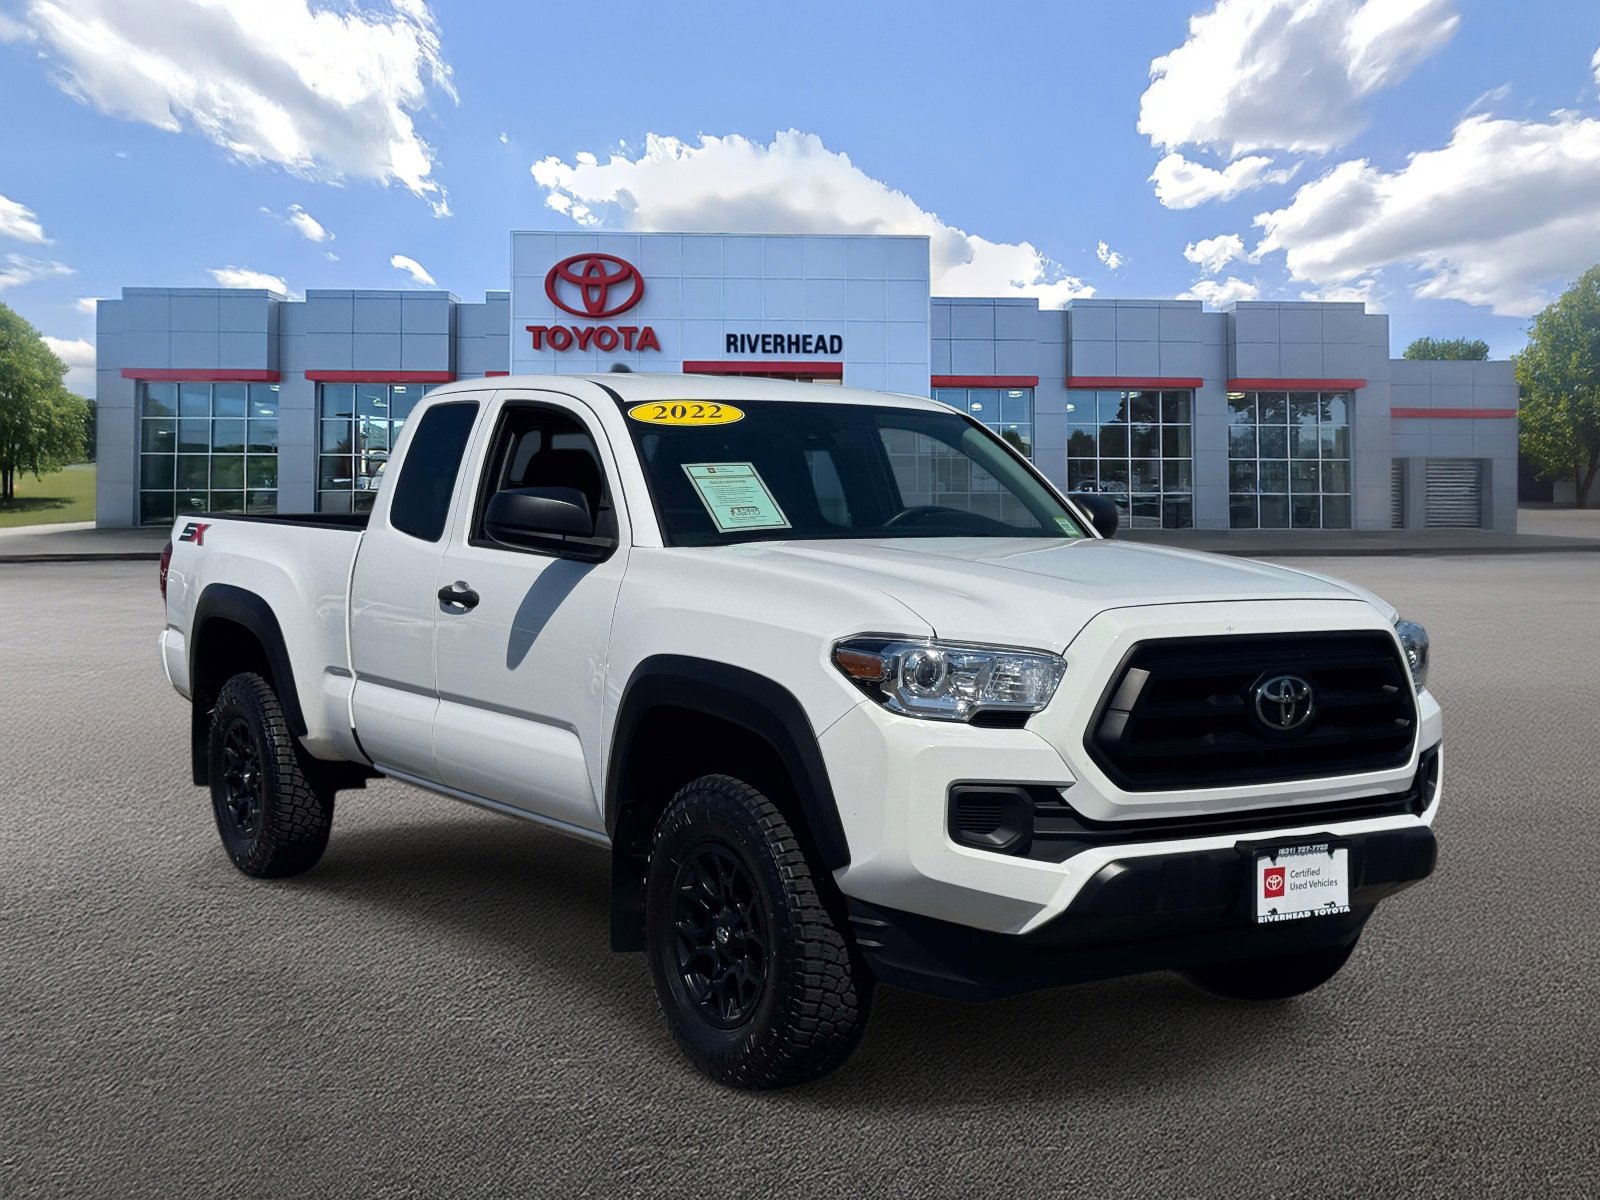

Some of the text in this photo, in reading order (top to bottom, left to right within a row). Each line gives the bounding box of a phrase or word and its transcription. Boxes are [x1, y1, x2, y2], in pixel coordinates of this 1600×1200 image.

[526, 325, 661, 352] TOYOTA
[725, 333, 843, 355] RIVERHEAD
[652, 404, 723, 420] 2022
[1278, 843, 1329, 856] (631) 727-7722
[1290, 867, 1321, 879] Certified
[1290, 878, 1338, 891] Used Vehicles
[1257, 905, 1351, 924] RIVERHEAD TOYOTA
